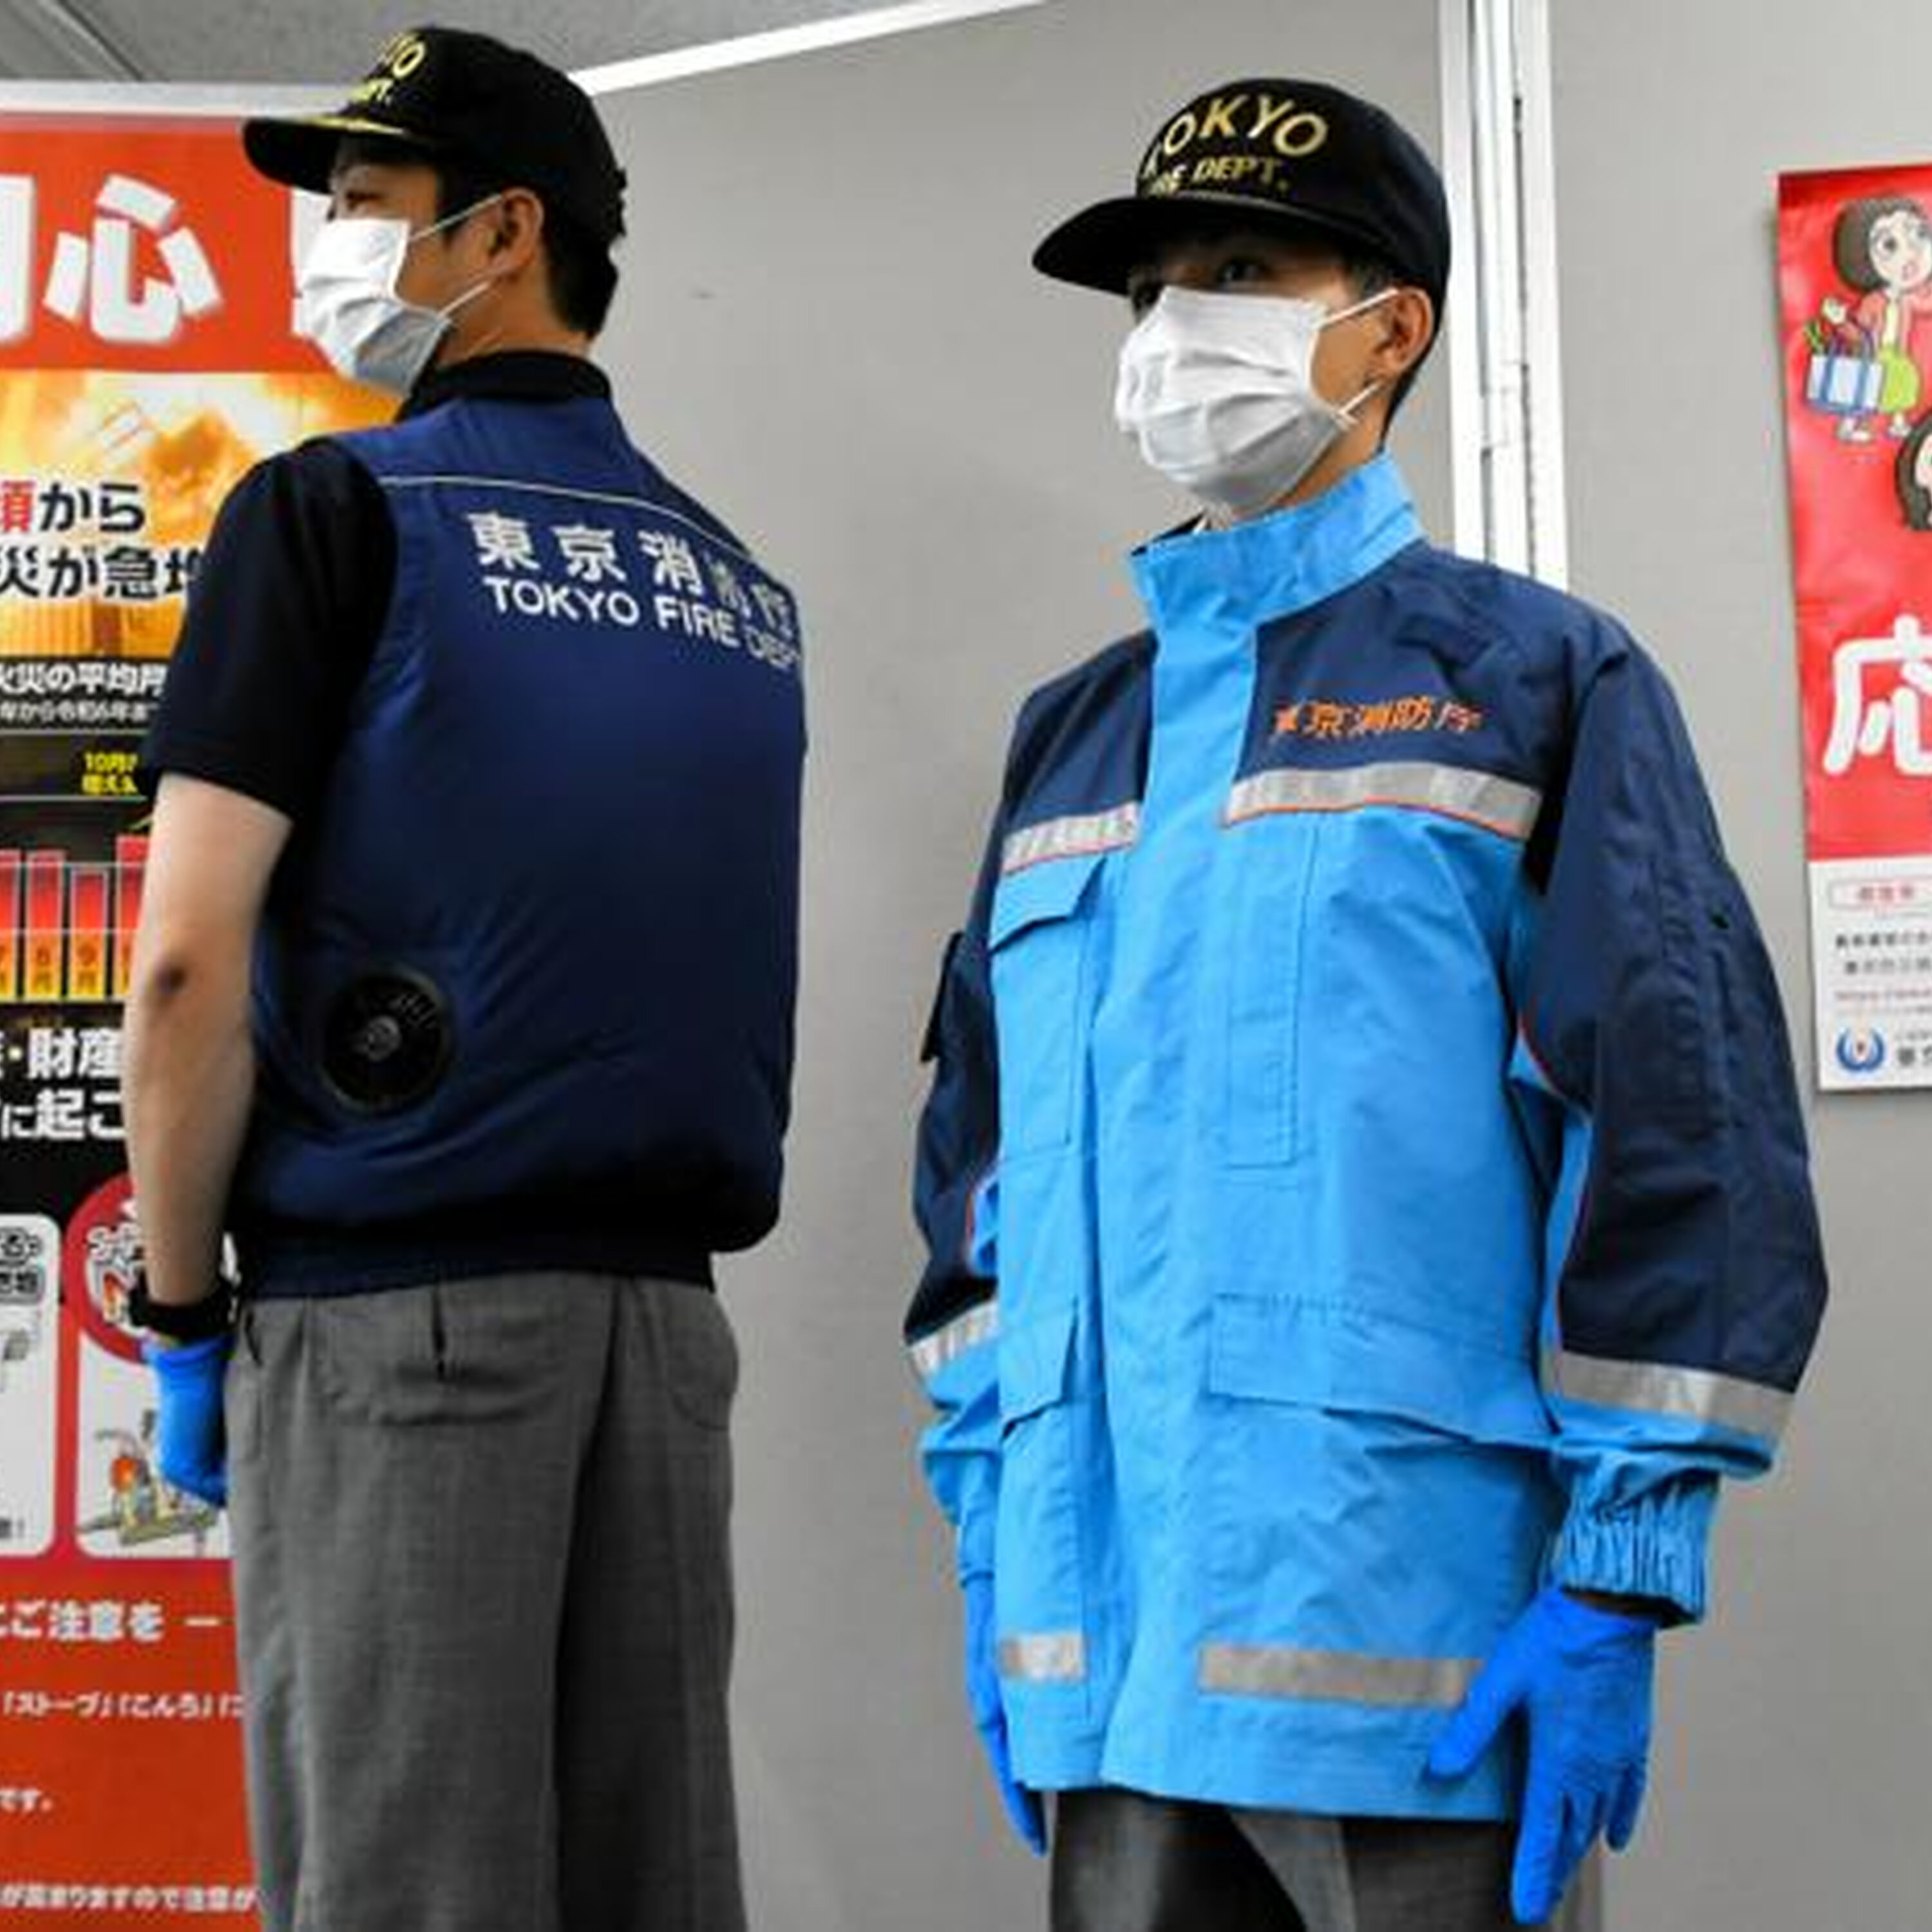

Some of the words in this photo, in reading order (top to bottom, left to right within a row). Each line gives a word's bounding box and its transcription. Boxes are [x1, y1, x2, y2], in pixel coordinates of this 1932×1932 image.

[0, 171, 225, 346] 心
[483, 577, 641, 626] TOKYO
[653, 595, 742, 648] FIRE
[0, 1028, 124, 1079] ・財産
